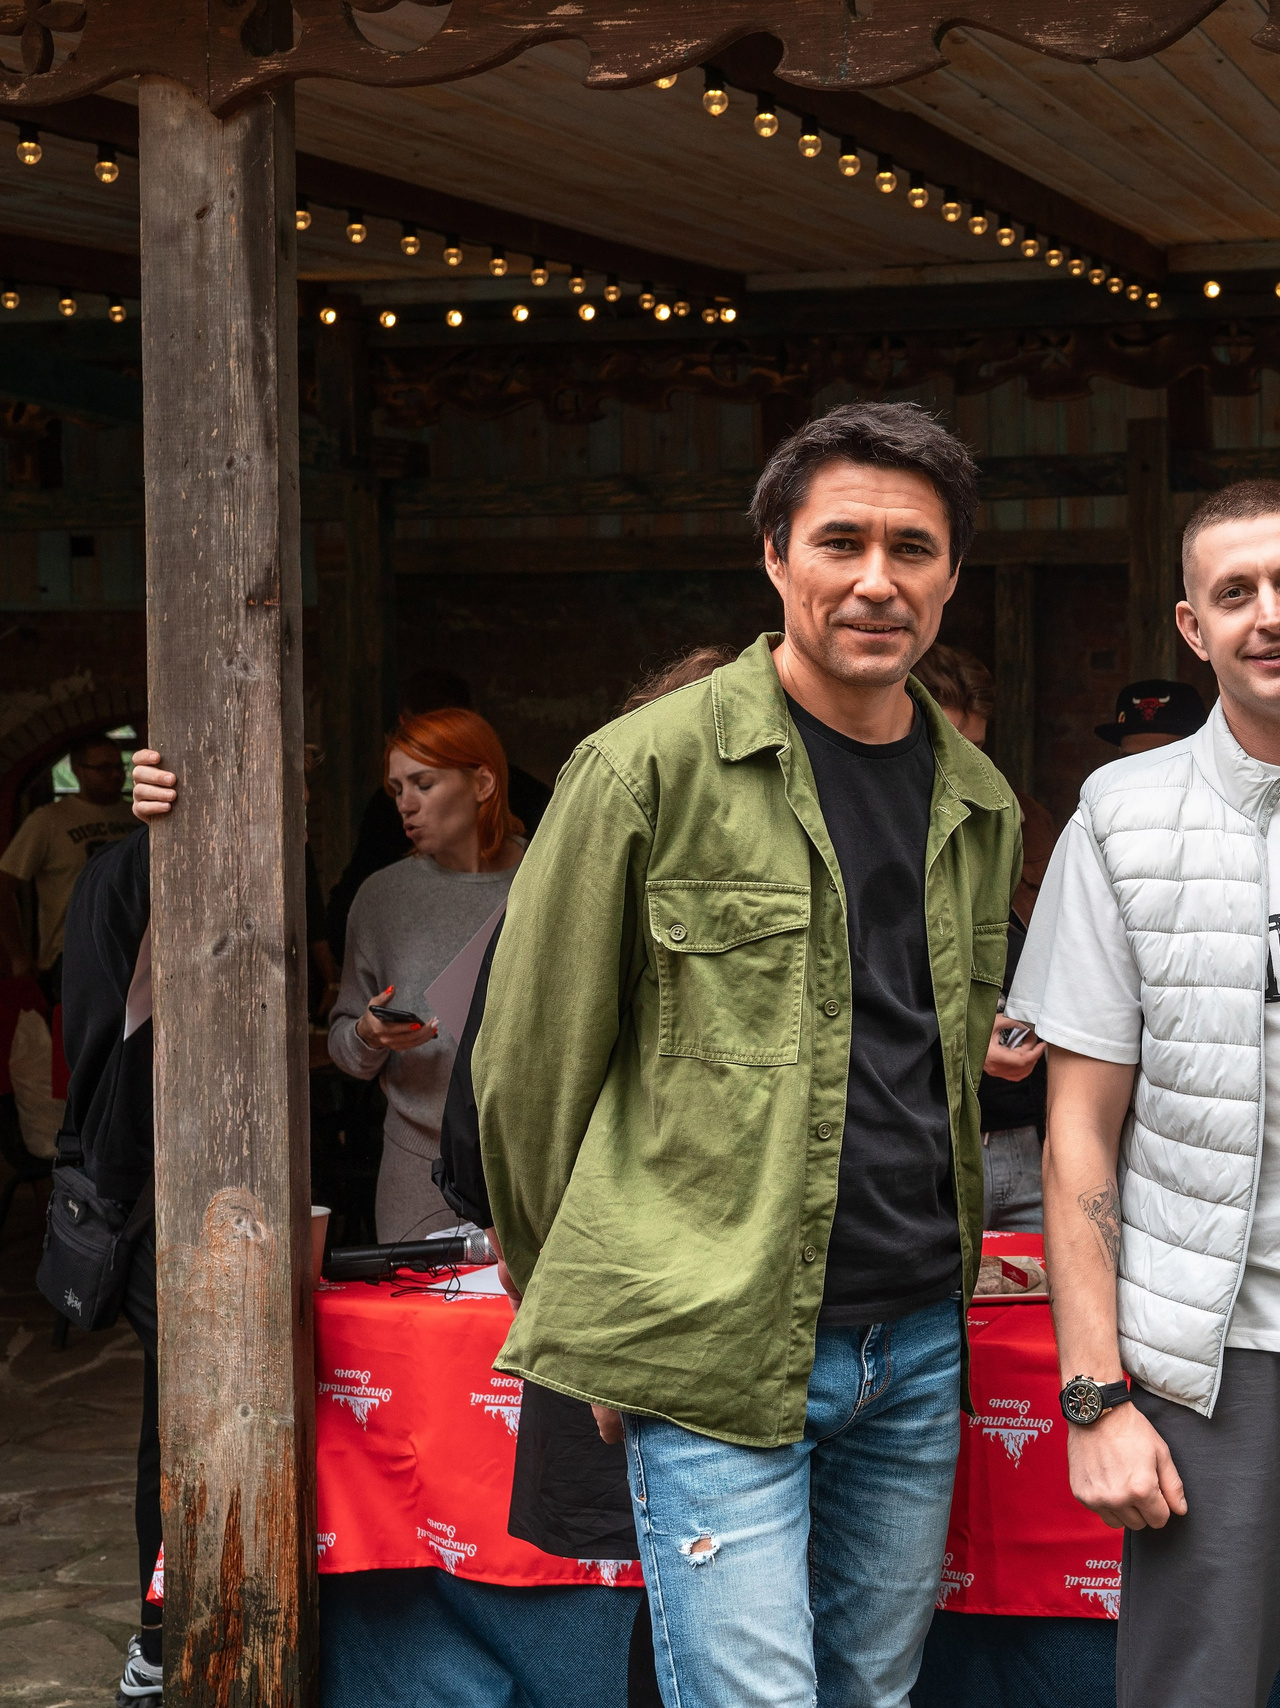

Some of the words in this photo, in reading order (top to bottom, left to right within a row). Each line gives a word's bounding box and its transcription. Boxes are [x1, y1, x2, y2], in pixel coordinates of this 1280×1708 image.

[334, 1369, 371, 1384] Огонь
[318, 1382, 392, 1402] Открытый
[470, 1392, 523, 1405] рытый
[989, 1399, 1031, 1414] Огонь
[969, 1415, 1053, 1433] Открытый
[427, 1518, 456, 1538] Огонь
[415, 1527, 477, 1557] Открытый
[1064, 1575, 1121, 1588] рытый
